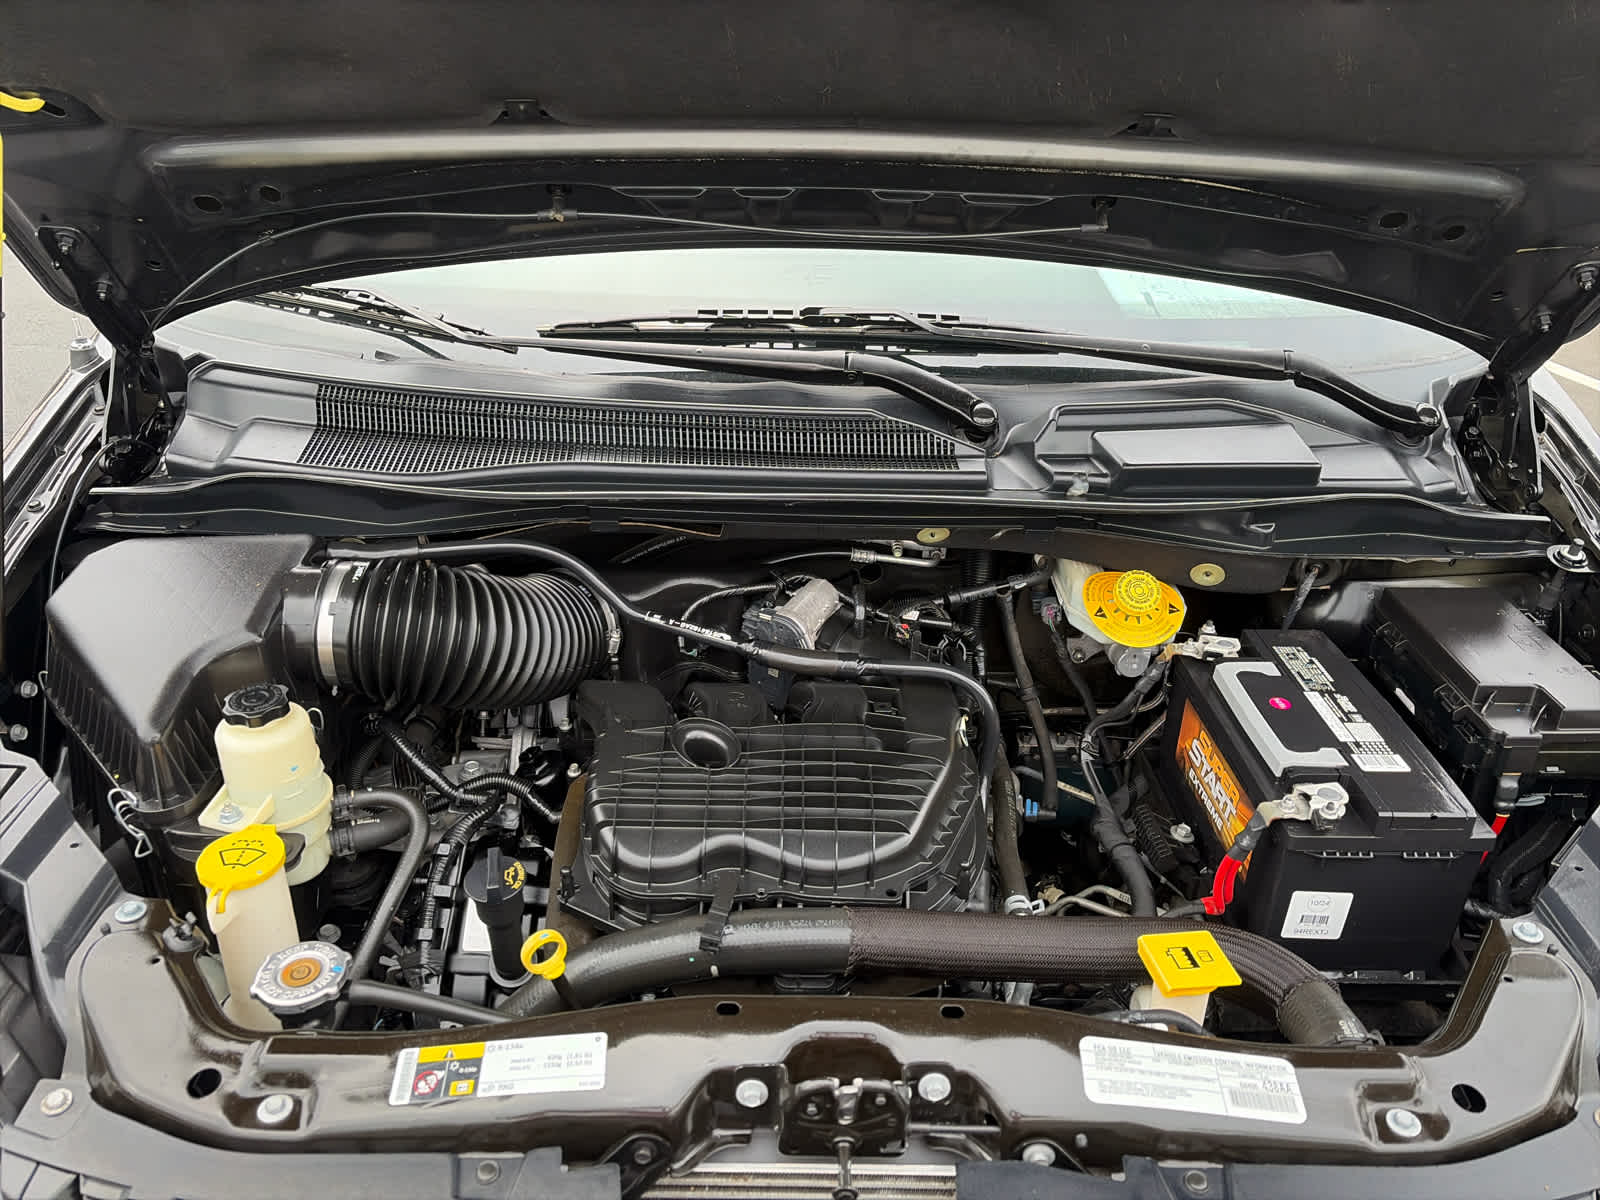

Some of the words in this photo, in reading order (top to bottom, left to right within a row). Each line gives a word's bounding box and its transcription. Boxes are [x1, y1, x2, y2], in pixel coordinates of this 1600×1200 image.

[1188, 738, 1237, 821] START
[1188, 767, 1224, 832] EXTREME
[1198, 730, 1241, 811] SUPER
